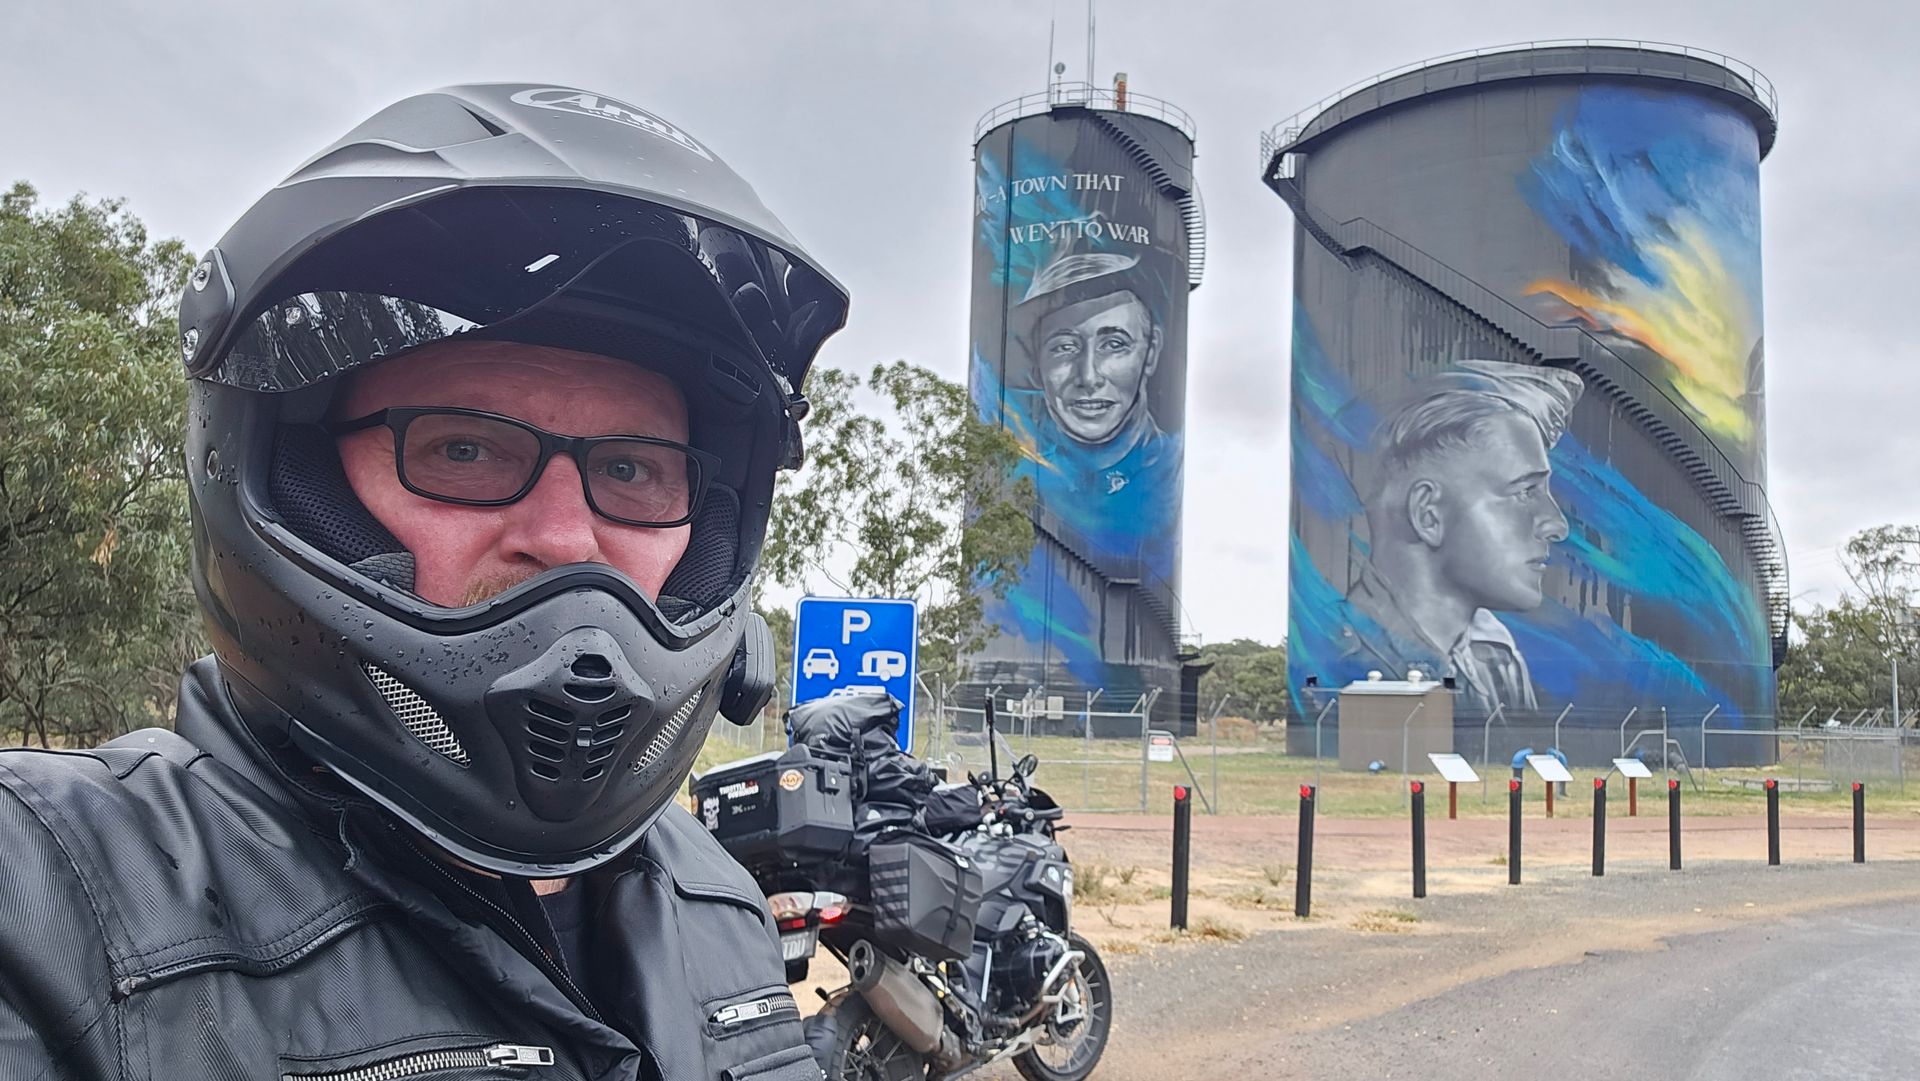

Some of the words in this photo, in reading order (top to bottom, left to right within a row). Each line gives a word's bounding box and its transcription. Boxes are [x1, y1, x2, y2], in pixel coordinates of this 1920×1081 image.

[1012, 174, 1067, 197] TOWN
[1072, 173, 1125, 191] THAT
[1010, 221, 1068, 245] WENT
[1074, 221, 1102, 239] TO
[1107, 222, 1150, 245] WAR
[842, 609, 871, 645] P
